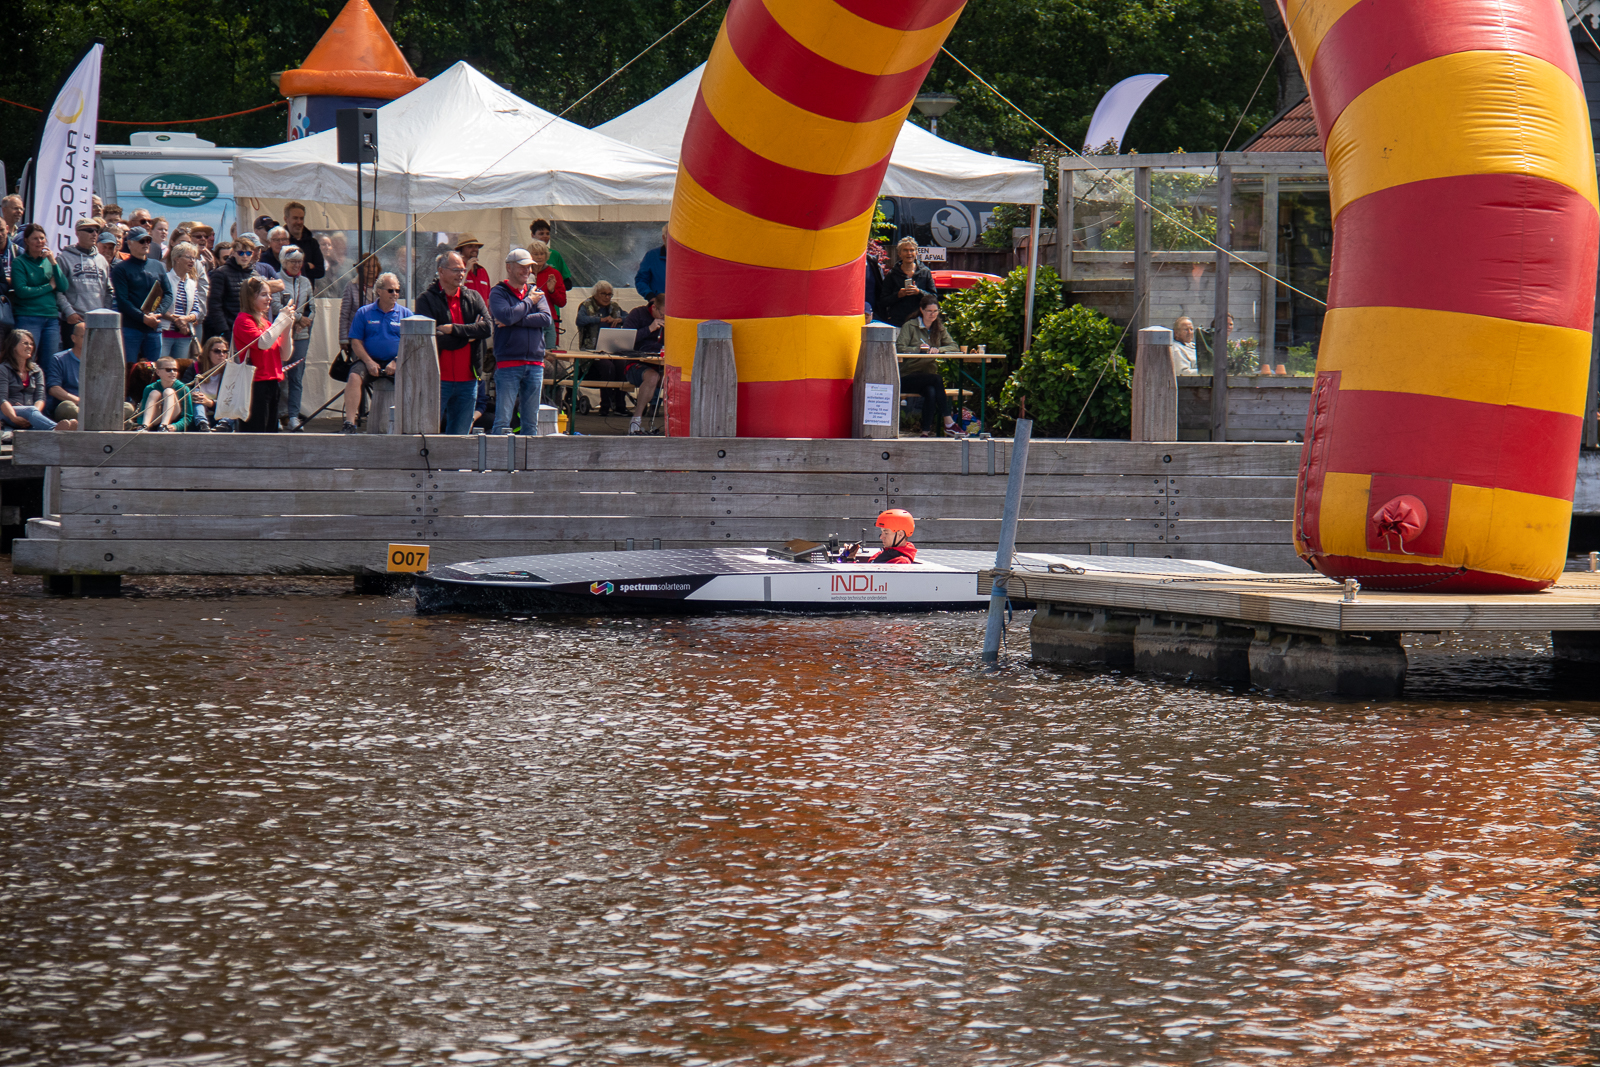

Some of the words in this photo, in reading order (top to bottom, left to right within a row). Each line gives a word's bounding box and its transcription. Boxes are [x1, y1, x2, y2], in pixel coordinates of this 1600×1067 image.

[57, 130, 78, 228] SOLAR
[79, 134, 91, 218] ALLENGE
[154, 181, 208, 191] Whisper
[620, 582, 690, 592] spectrumsolarteam
[831, 574, 888, 592] INDI.nl
